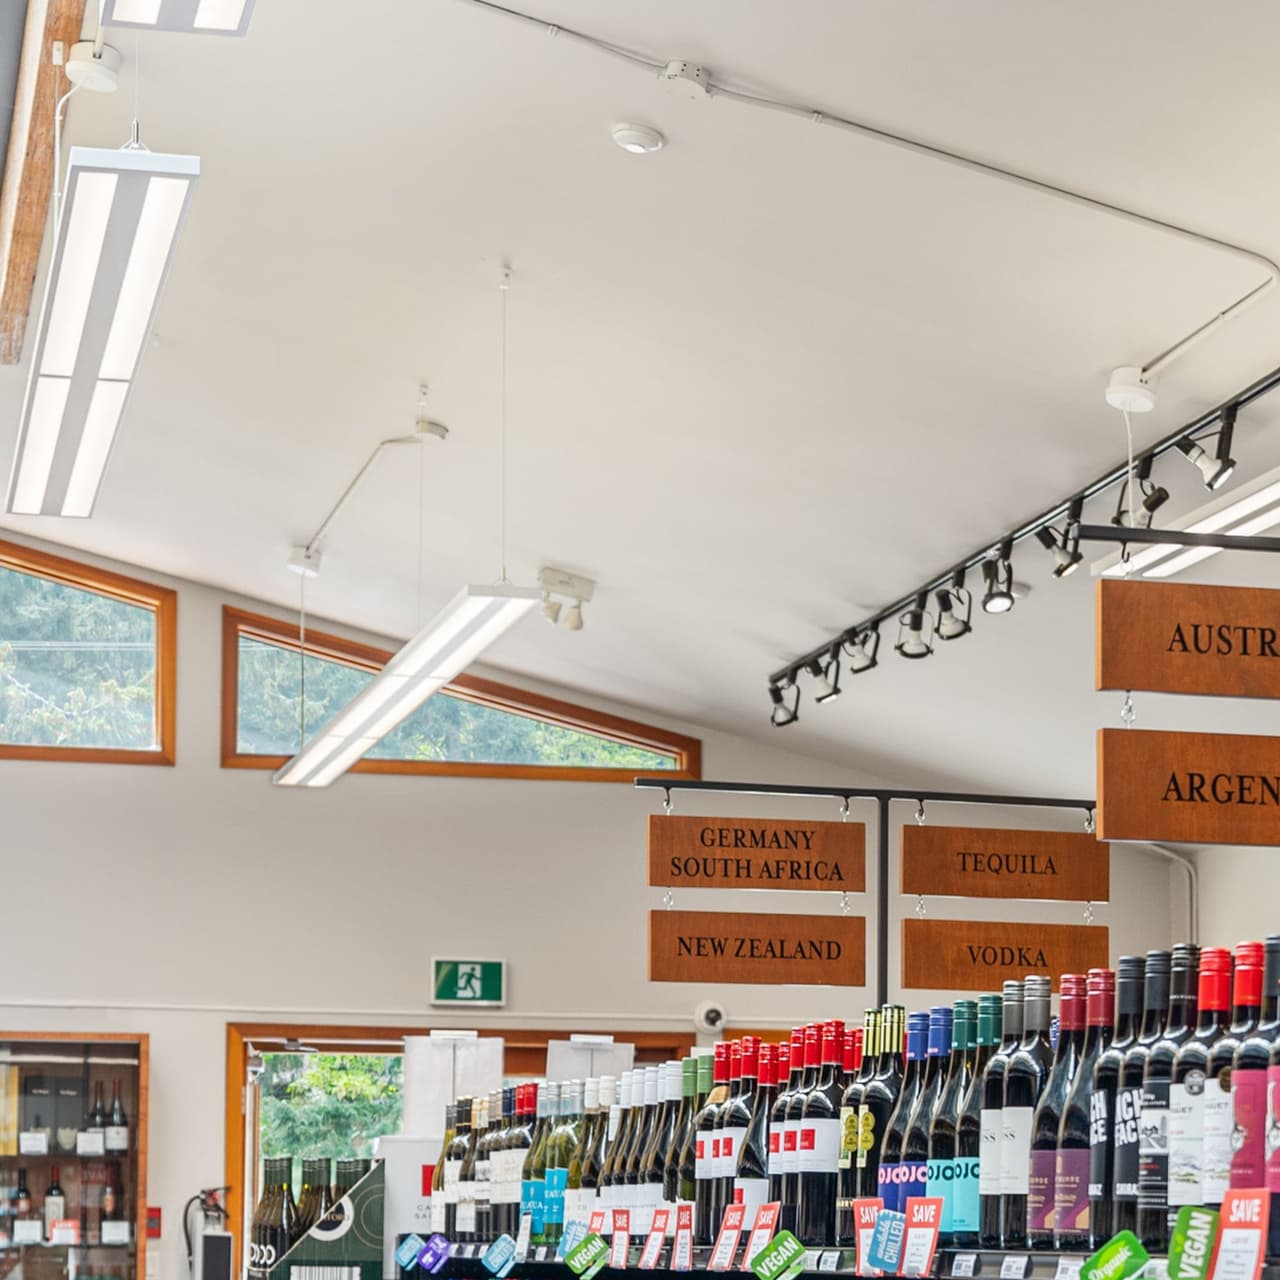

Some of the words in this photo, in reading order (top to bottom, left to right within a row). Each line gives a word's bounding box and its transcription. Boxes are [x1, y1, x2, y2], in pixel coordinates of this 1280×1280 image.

[699, 827, 816, 851] GERMANY
[670, 856, 752, 880] SOUTH
[758, 858, 844, 882] AFRICA
[956, 851, 1058, 876] TEQUILA
[676, 936, 729, 959] NEW
[734, 937, 842, 961] ZEALAND
[967, 944, 1048, 967] VODKA
[679, 1210, 690, 1224] SAVE
[727, 1209, 742, 1226] SAVE
[758, 1209, 774, 1225] SAVE
[912, 1204, 936, 1223] SAVE
[1229, 1198, 1261, 1222] SAVE
[570, 1239, 604, 1269] VEGAN
[883, 1220, 905, 1265] CHILLED
[1177, 1211, 1215, 1280] VEGAN
[756, 1237, 799, 1278] VEGAN
